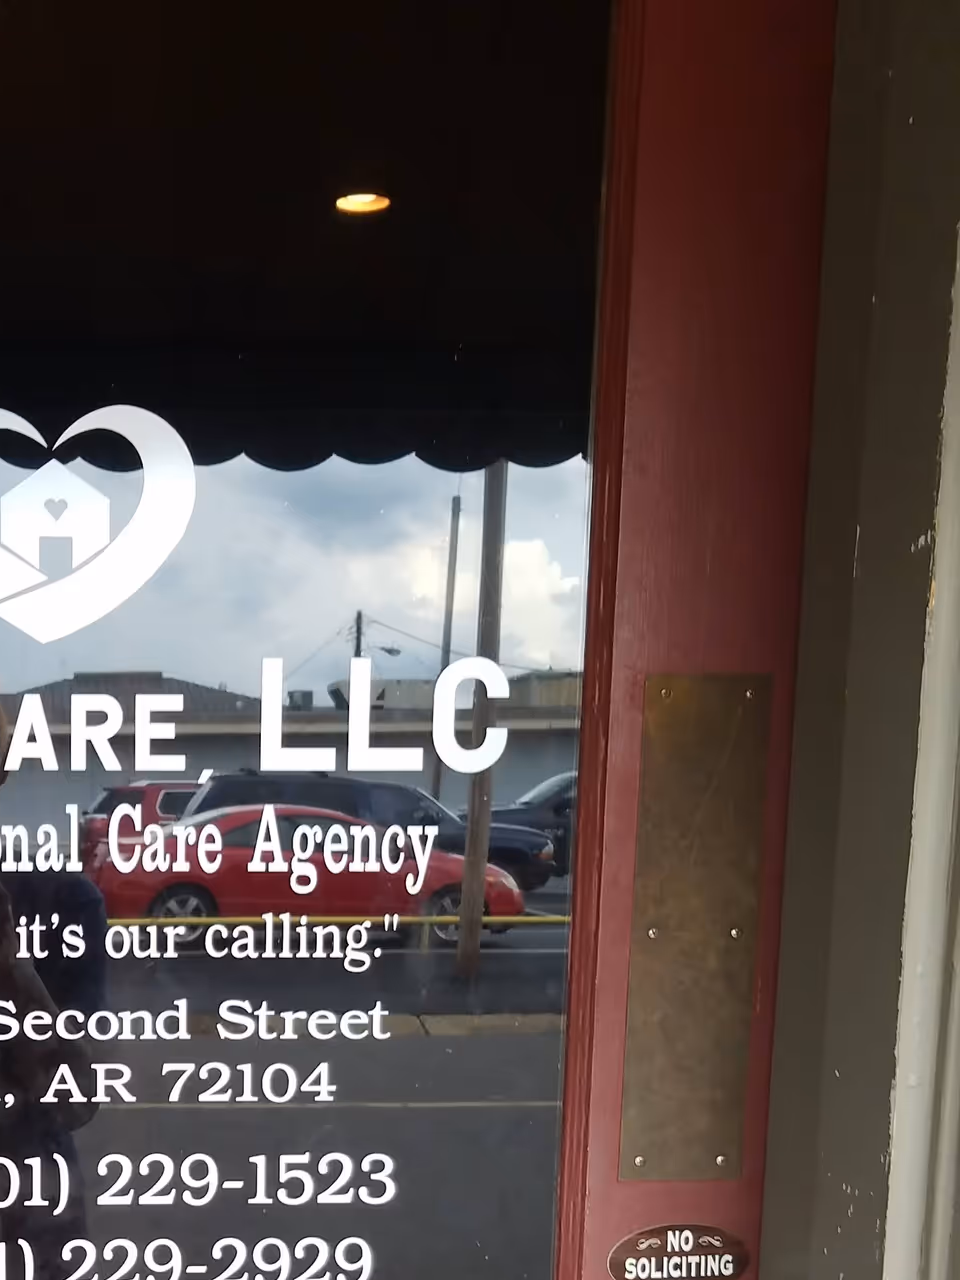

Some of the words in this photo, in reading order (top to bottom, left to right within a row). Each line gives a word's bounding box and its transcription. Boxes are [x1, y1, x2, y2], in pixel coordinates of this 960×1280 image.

[260, 656, 510, 774] LLC
[108, 803, 223, 874] Care
[247, 803, 439, 895] Agency
[16, 912, 86, 959] it's
[105, 923, 186, 959] our
[204, 911, 399, 972] calling."
[216, 999, 391, 1040] Street
[40, 1063, 137, 1103] AR
[161, 1061, 337, 1103] 72104
[96, 1151, 396, 1206] 229-1523
[667, 1229, 694, 1252] NO
[624, 1254, 733, 1280] SOLICITING
